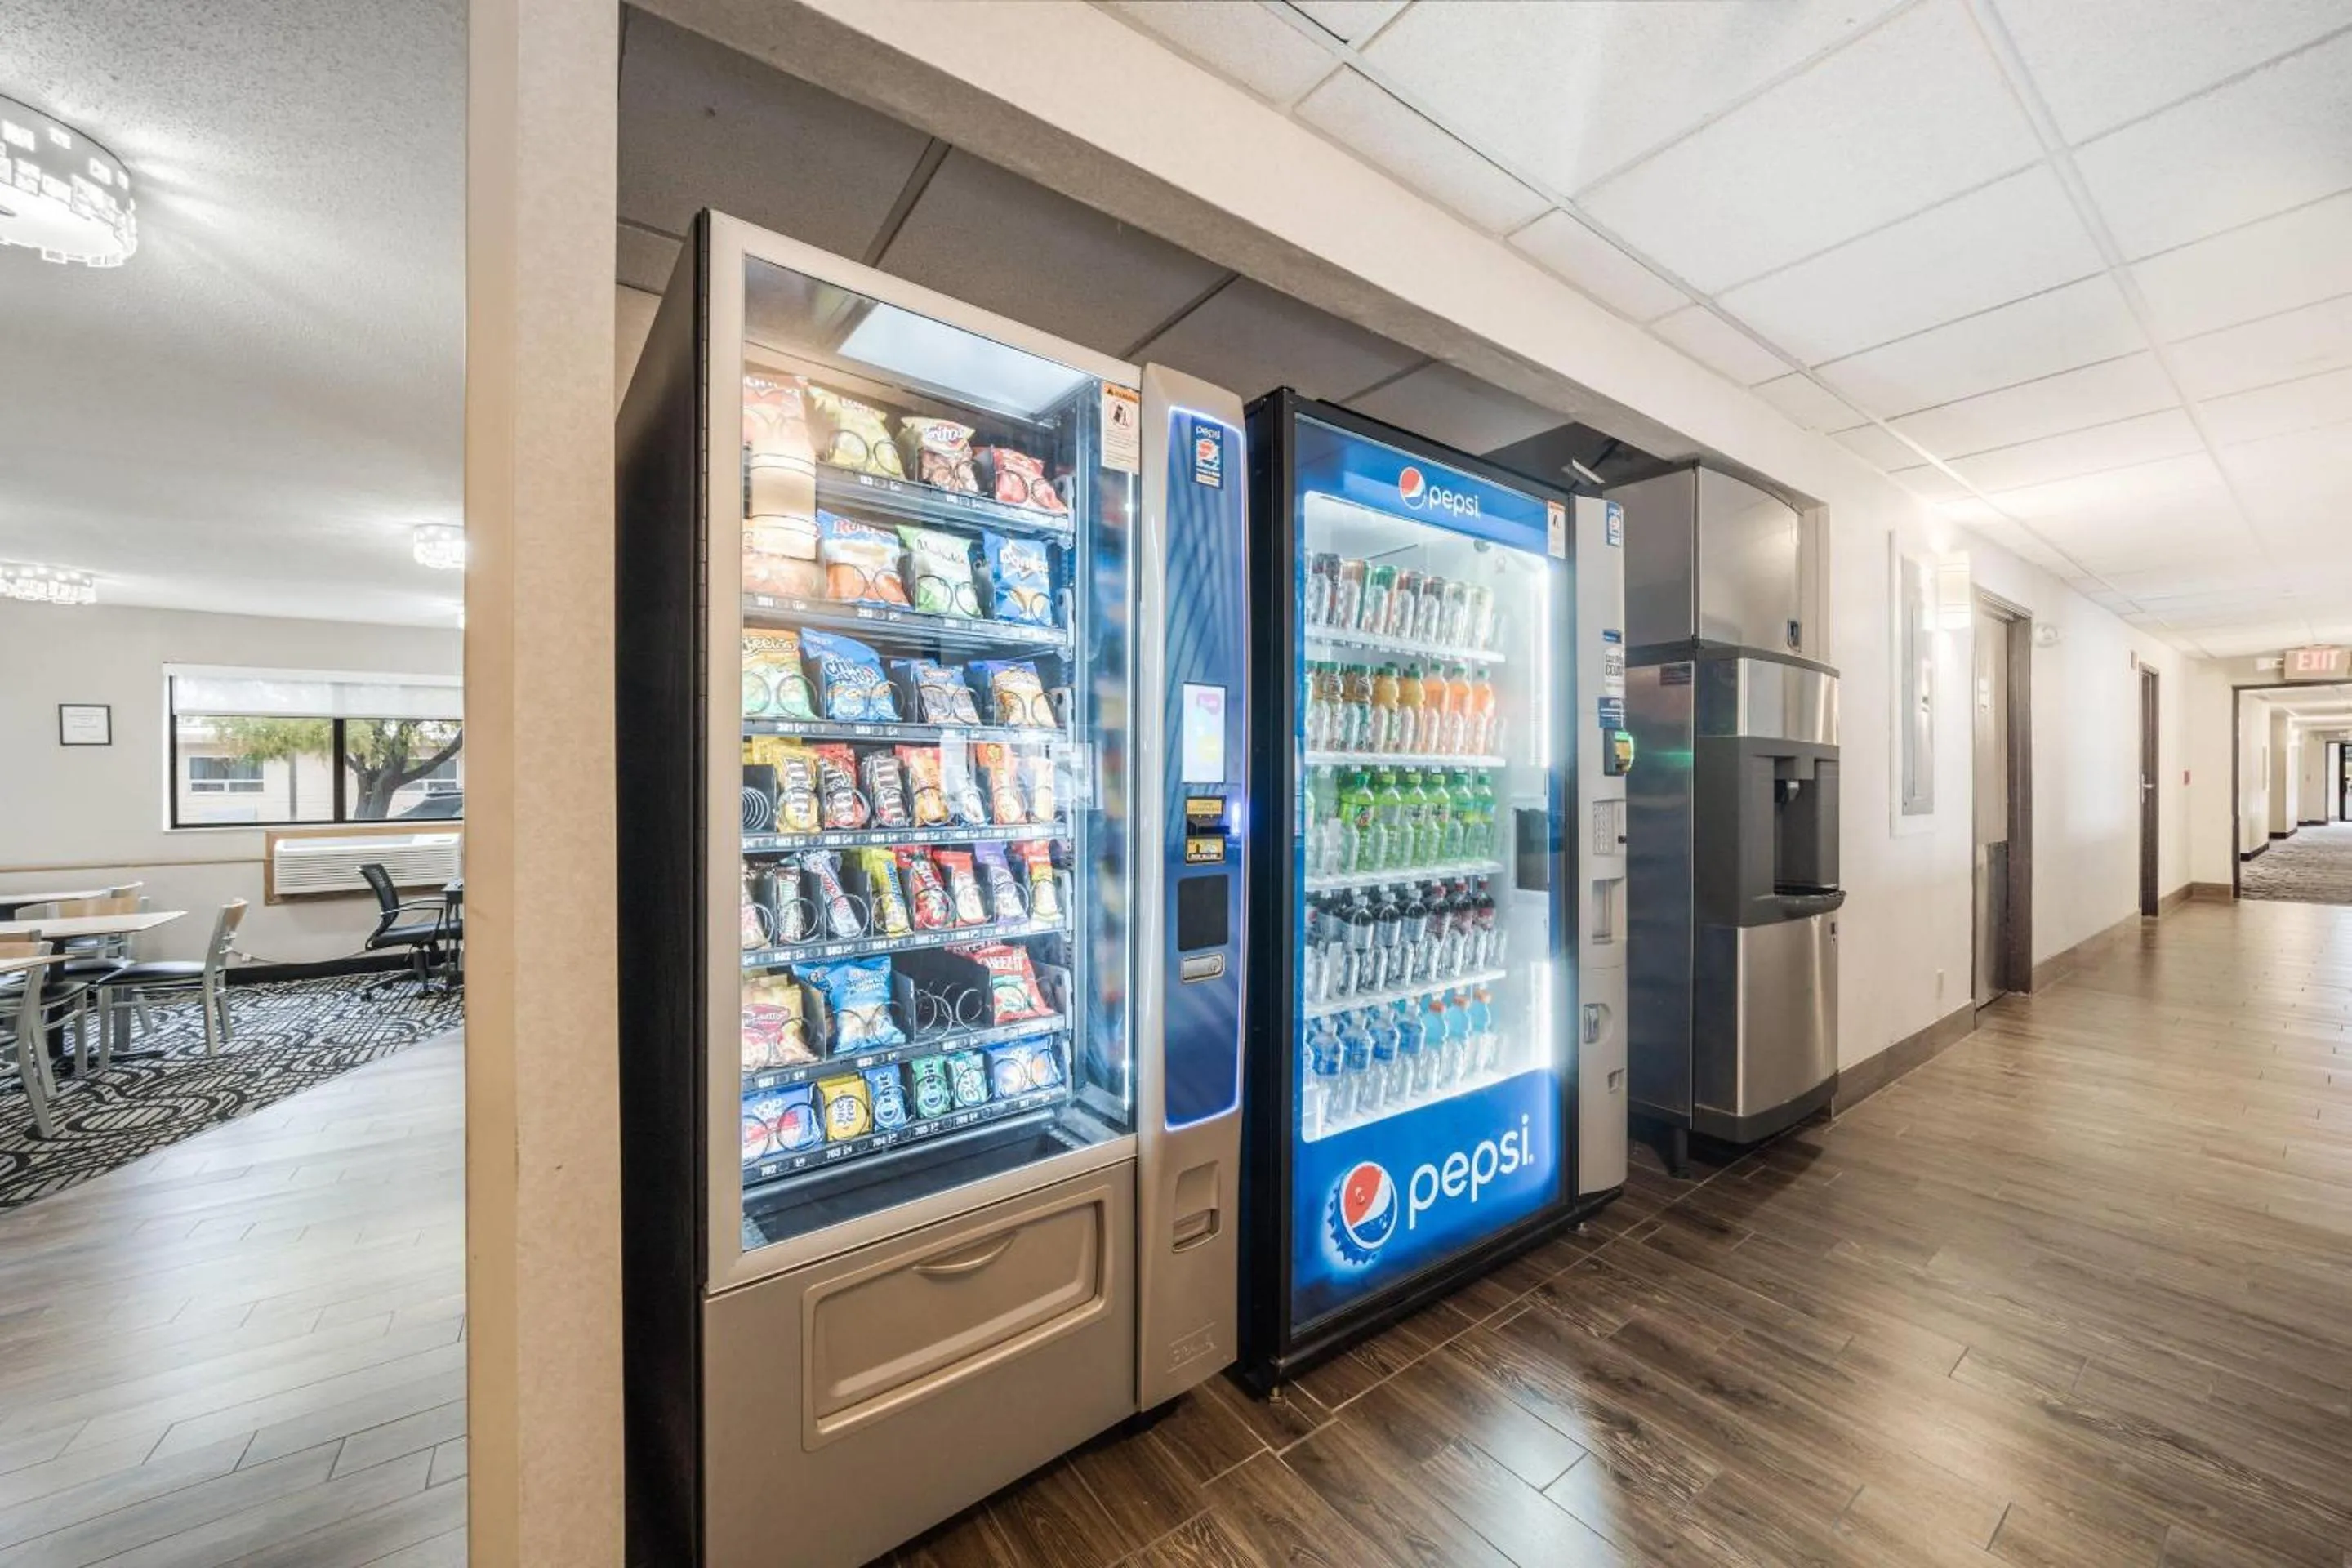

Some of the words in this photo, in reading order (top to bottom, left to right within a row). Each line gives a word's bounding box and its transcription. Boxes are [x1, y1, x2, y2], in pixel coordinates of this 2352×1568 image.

[1429, 485, 1480, 519] pepsi
[2297, 651, 2340, 670] EXIT
[1409, 1113, 1529, 1230] pepsi
